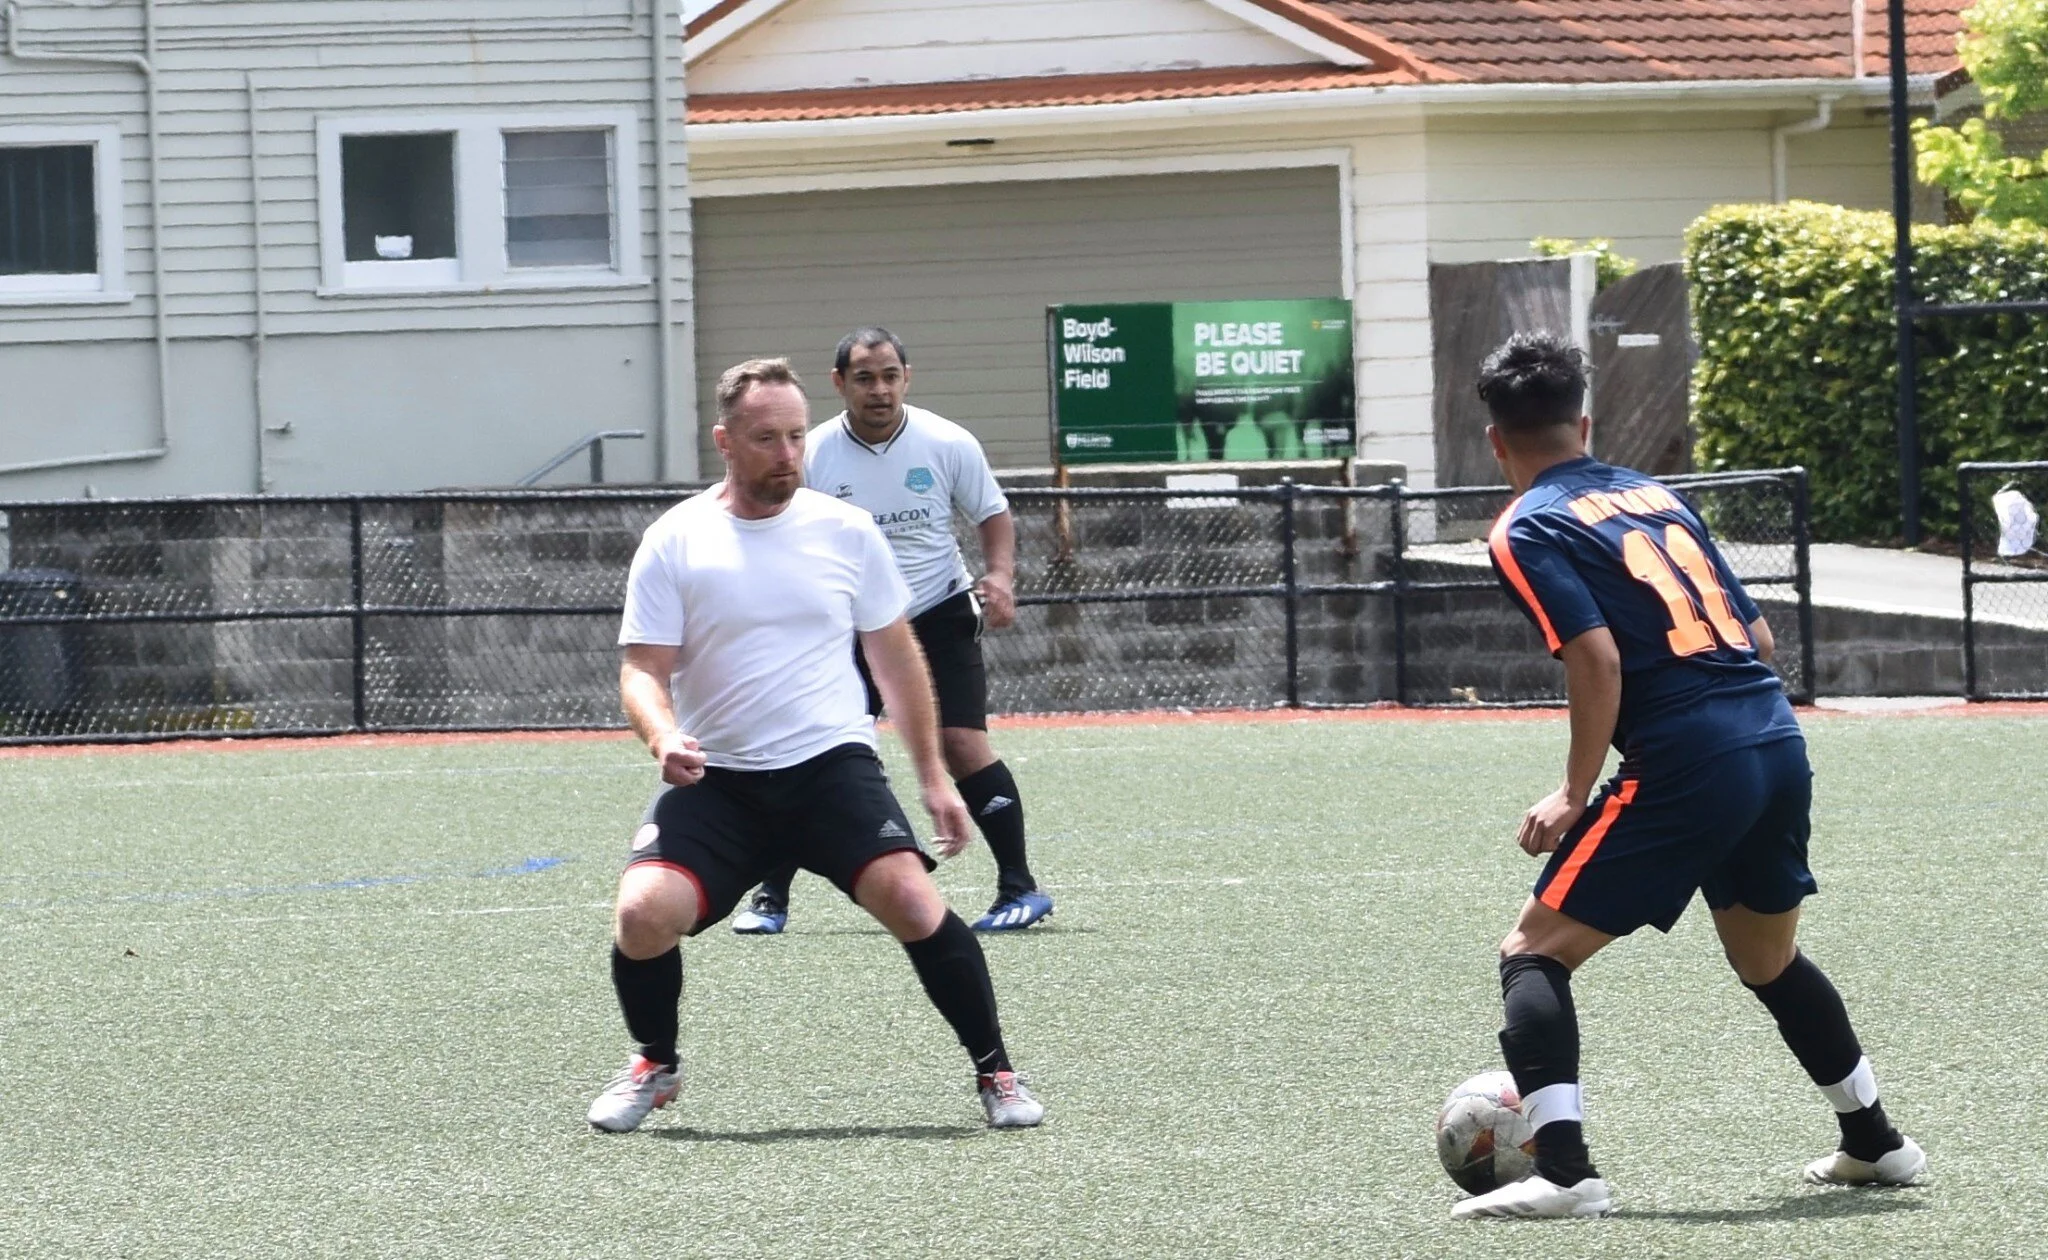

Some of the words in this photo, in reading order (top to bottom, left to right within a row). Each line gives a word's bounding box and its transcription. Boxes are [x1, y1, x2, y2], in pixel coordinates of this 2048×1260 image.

[1063, 317, 1117, 342] Boyd-
[1195, 322, 1283, 347] PLEASE
[1063, 343, 1126, 363] Wilson
[1196, 352, 1227, 376] BE
[1231, 350, 1304, 375] QUIET
[1064, 368, 1111, 389] Field
[1623, 524, 1752, 656] 11
